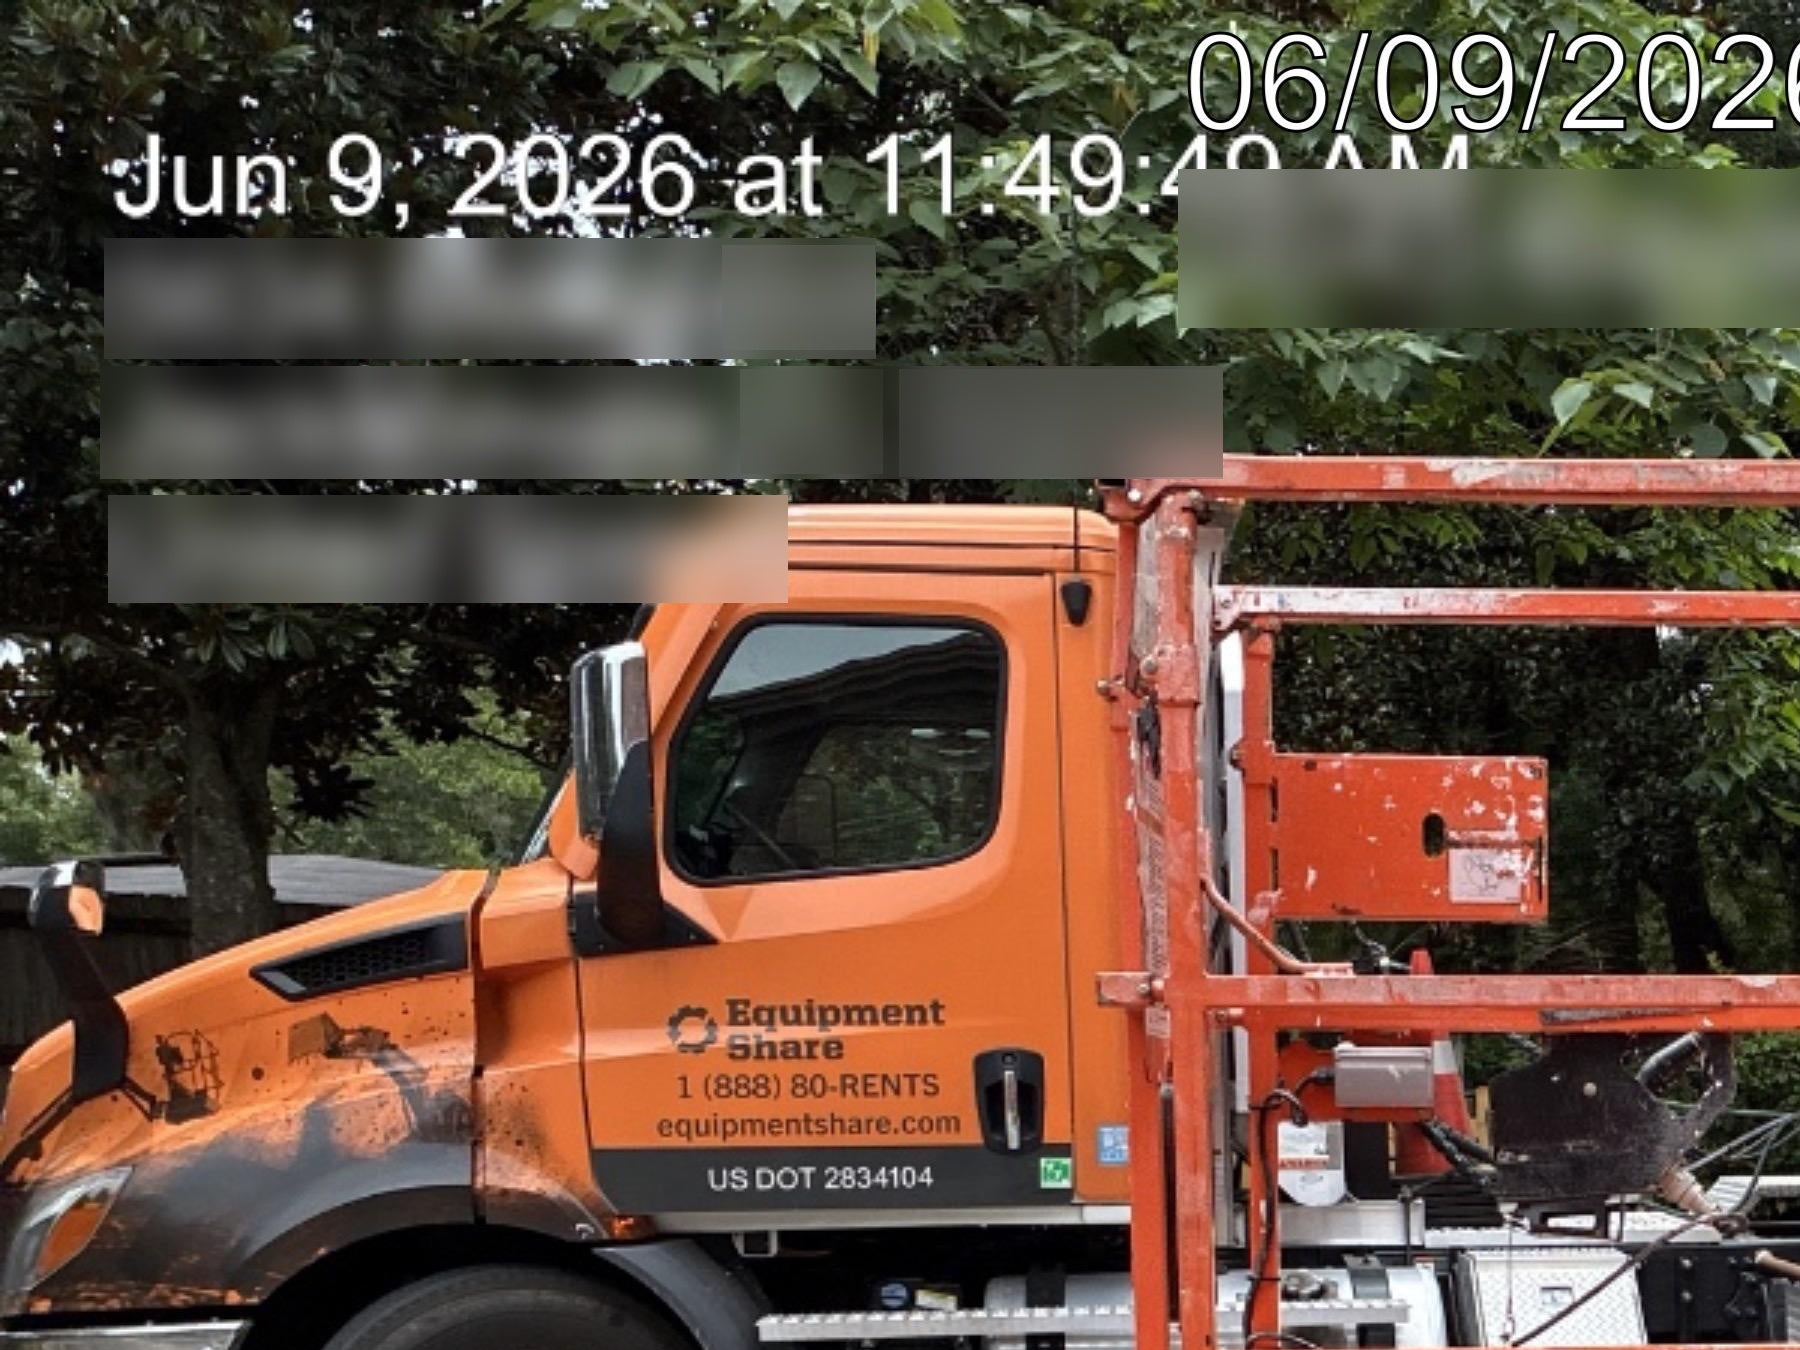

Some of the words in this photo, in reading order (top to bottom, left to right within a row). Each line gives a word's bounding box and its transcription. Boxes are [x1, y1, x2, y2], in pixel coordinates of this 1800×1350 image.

[725, 998, 945, 1031] Equipment
[727, 1035, 844, 1060] Share
[677, 1076, 691, 1098] 1
[704, 1074, 780, 1100] (888)
[791, 1074, 940, 1098] 80-RENTS
[656, 1113, 961, 1141] equipmentshare.com
[707, 1167, 748, 1191] US
[756, 1166, 816, 1190] DOT
[824, 1165, 934, 1189] 2834104
